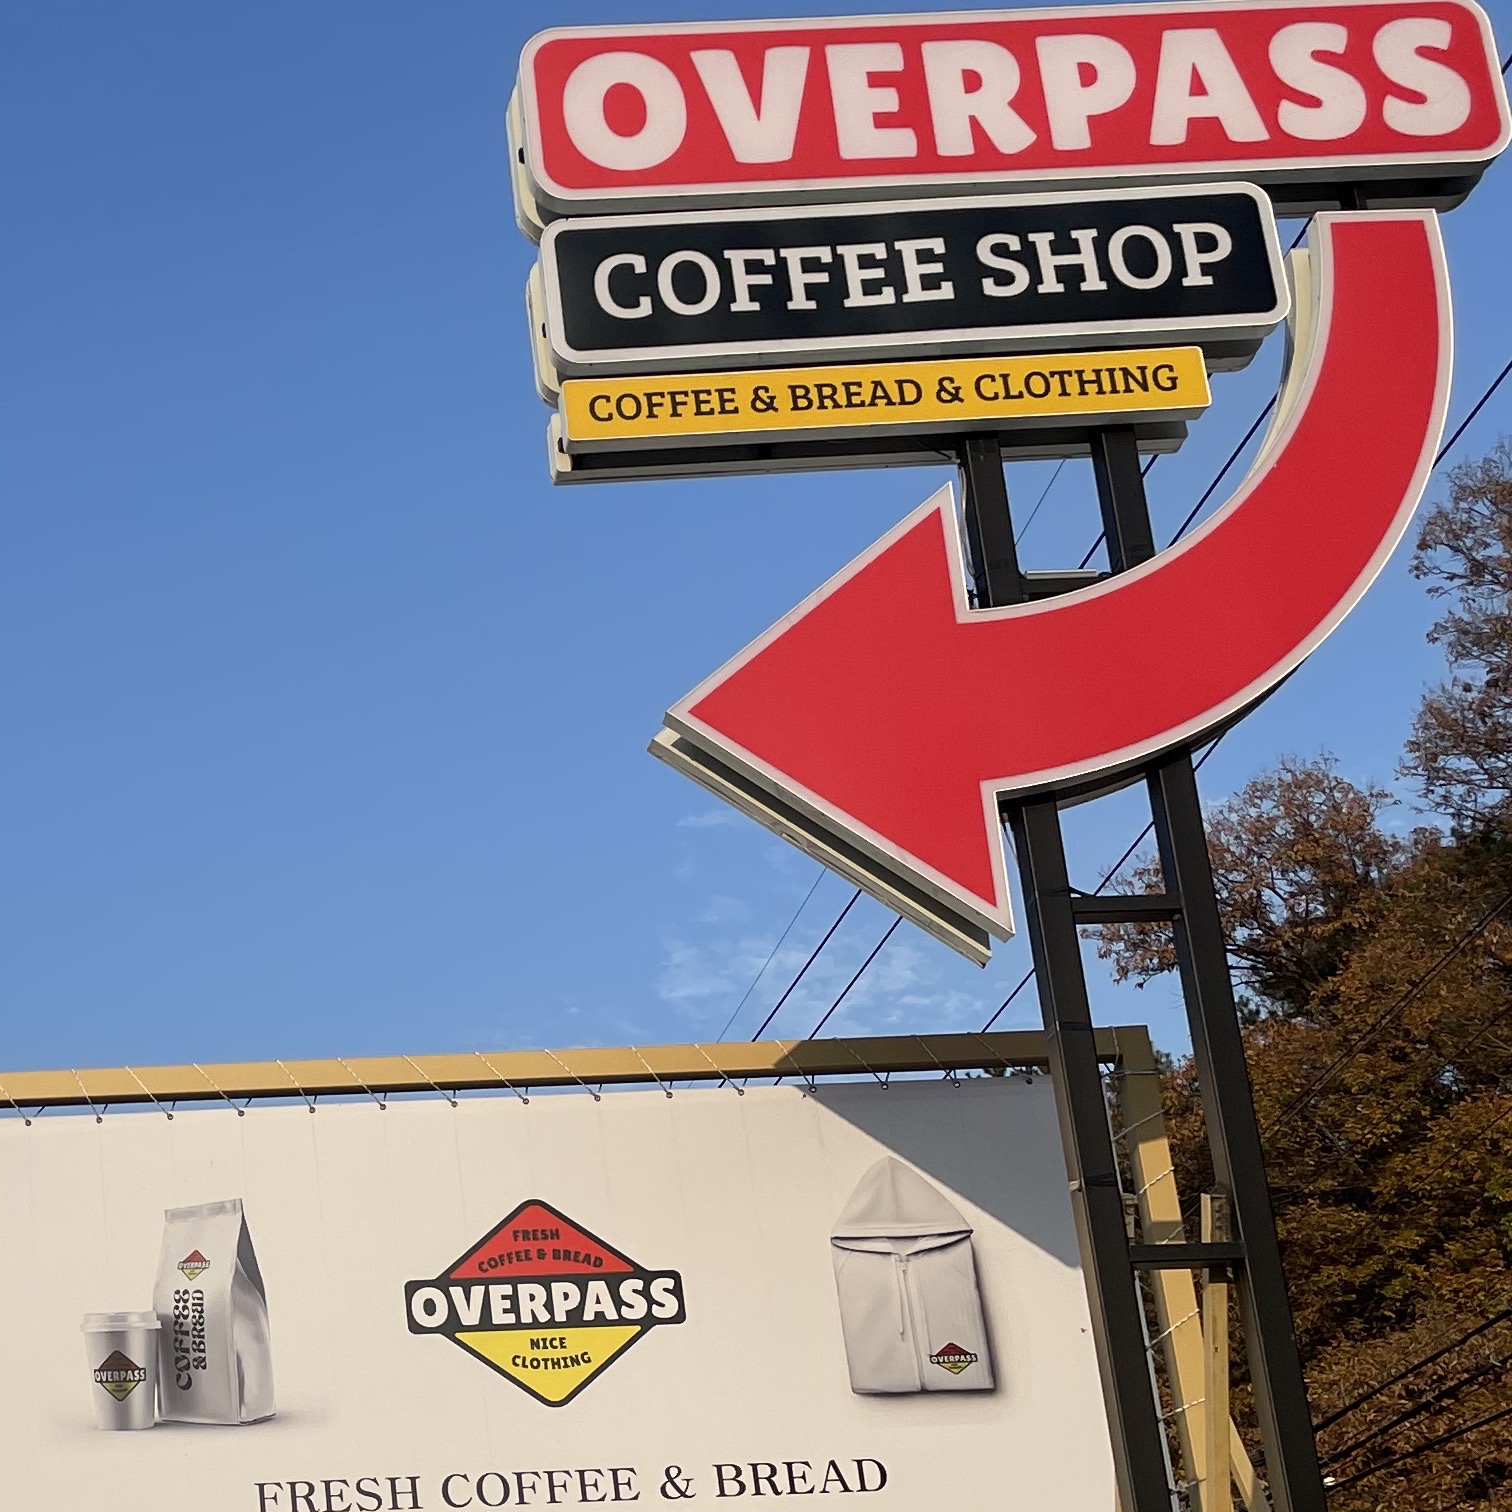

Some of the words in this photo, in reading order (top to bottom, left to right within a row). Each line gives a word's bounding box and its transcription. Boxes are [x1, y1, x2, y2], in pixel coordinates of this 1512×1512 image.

[561, 17, 1472, 172] OVERPASS
[593, 235, 955, 320] COFFEE
[978, 222, 1233, 298] SHOP
[588, 387, 740, 423] COFFEE
[749, 385, 780, 414] &
[786, 378, 923, 412] BREAD
[935, 375, 965, 405] &
[973, 363, 1179, 402] CLOTHING
[512, 1228, 560, 1243] FRESH
[477, 1249, 533, 1274] COFFEE
[536, 1248, 548, 1260] &
[552, 1248, 604, 1269] BREAD
[411, 1277, 680, 1328] OVERPASS
[511, 1352, 592, 1371] CLOTHING
[529, 1337, 567, 1350] NICE
[94, 1369, 146, 1382] OVERPASS
[441, 1467, 641, 1509] COFFEE
[659, 1464, 697, 1500] &
[711, 1458, 888, 1498] BREAD
